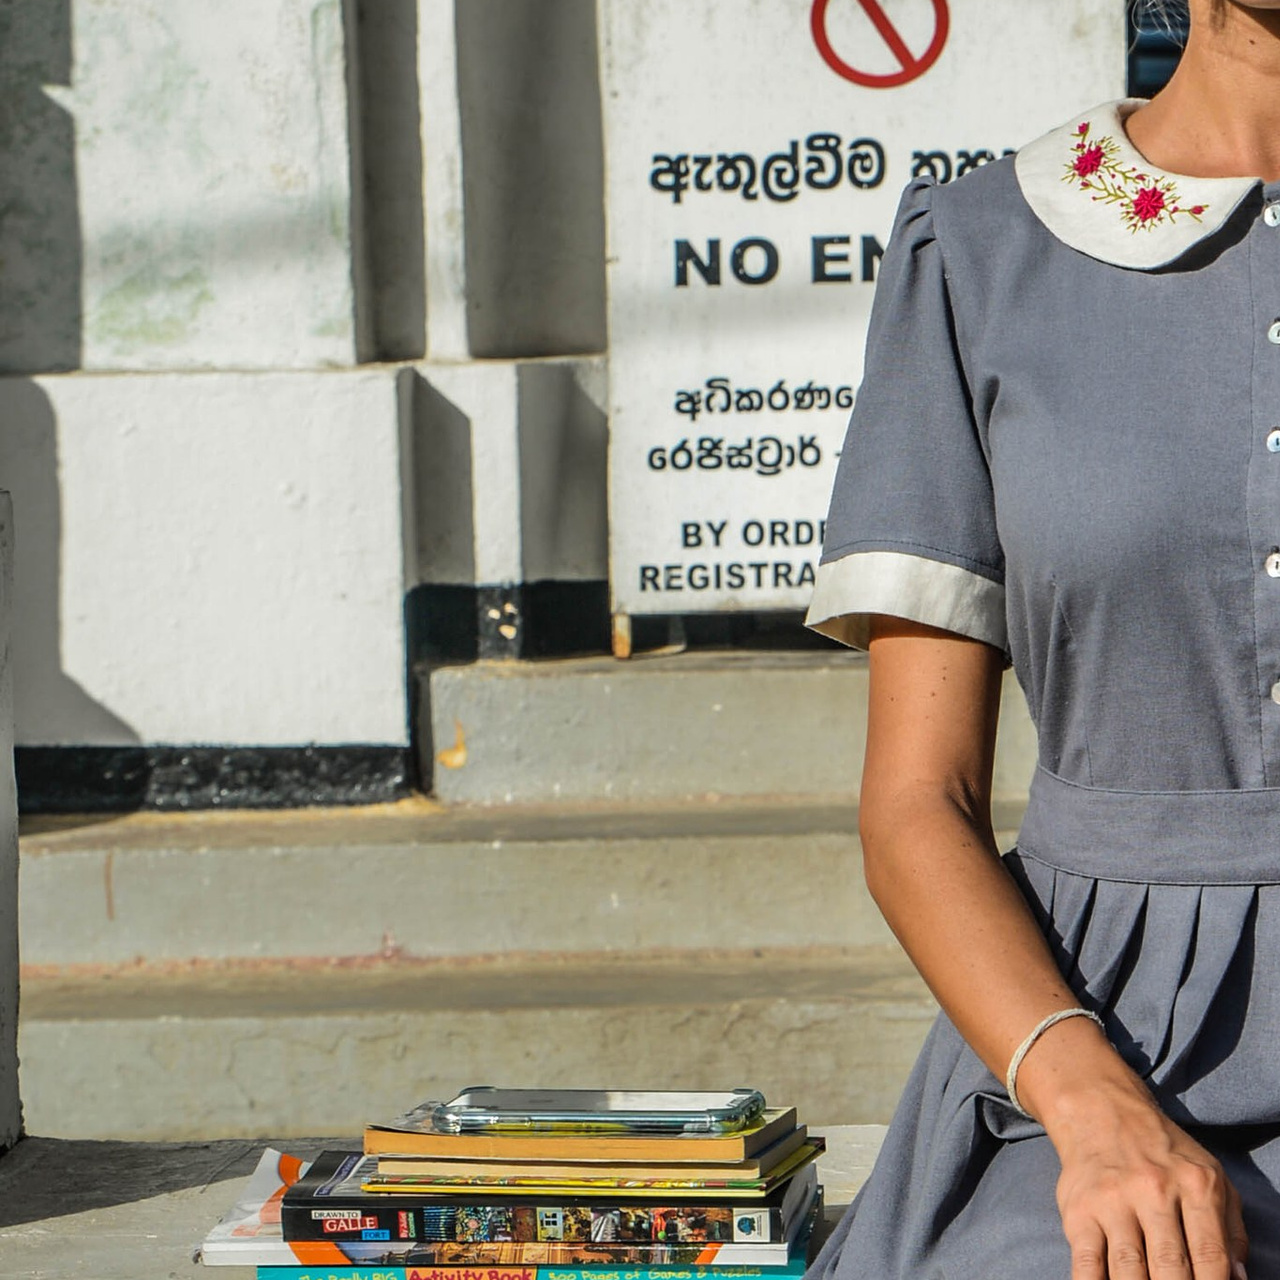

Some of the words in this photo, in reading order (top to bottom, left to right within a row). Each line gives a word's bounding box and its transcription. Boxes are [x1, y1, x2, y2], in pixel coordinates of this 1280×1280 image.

[650, 132, 886, 204] ඇතුල්වීම
[674, 236, 779, 286] NO
[682, 520, 727, 548] BY
[640, 562, 816, 592] REGISTRA
[325, 1217, 376, 1232] GALLE
[364, 1231, 386, 1239] FORT
[625, 1268, 643, 1280] of
[648, 1267, 692, 1280] Games
[713, 1265, 762, 1277] Puzzles
